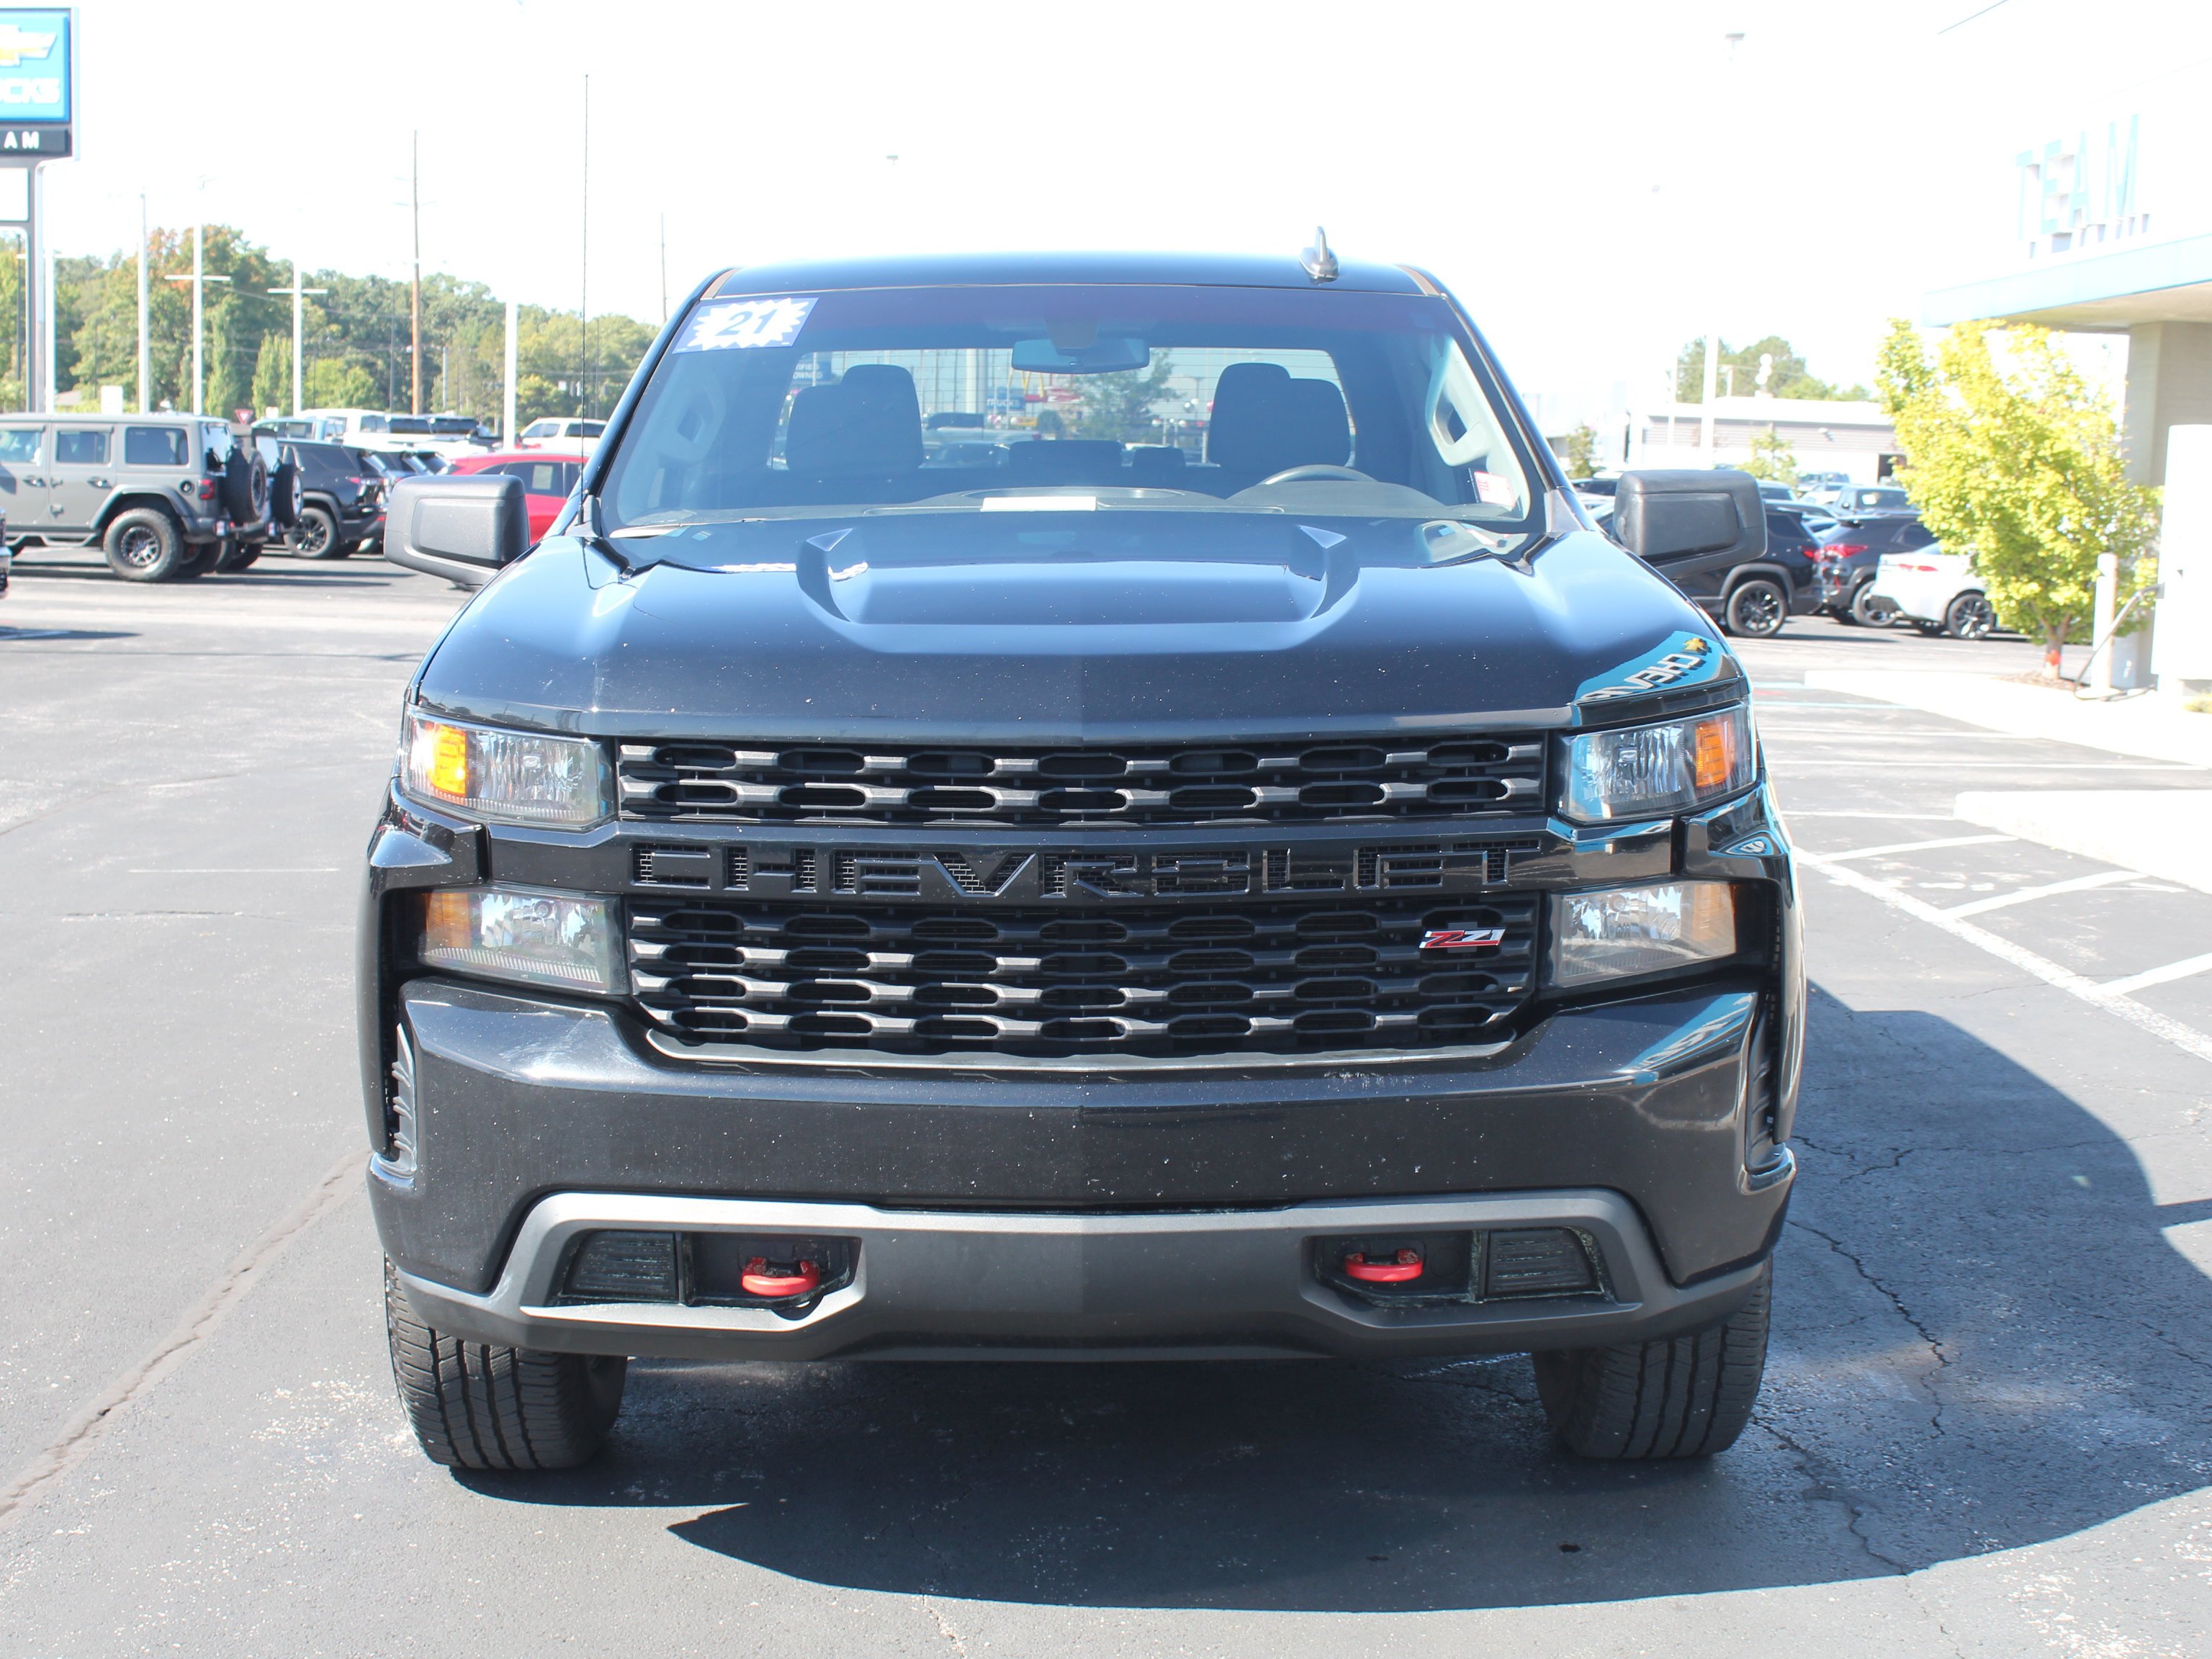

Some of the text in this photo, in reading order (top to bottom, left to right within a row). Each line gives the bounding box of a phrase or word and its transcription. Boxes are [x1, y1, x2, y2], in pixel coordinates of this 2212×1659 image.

[2015, 113, 2149, 258] TEAM
[714, 308, 779, 336] 21
[629, 838, 1541, 898] CHEVROLET
[1419, 929, 1506, 948] Z71
